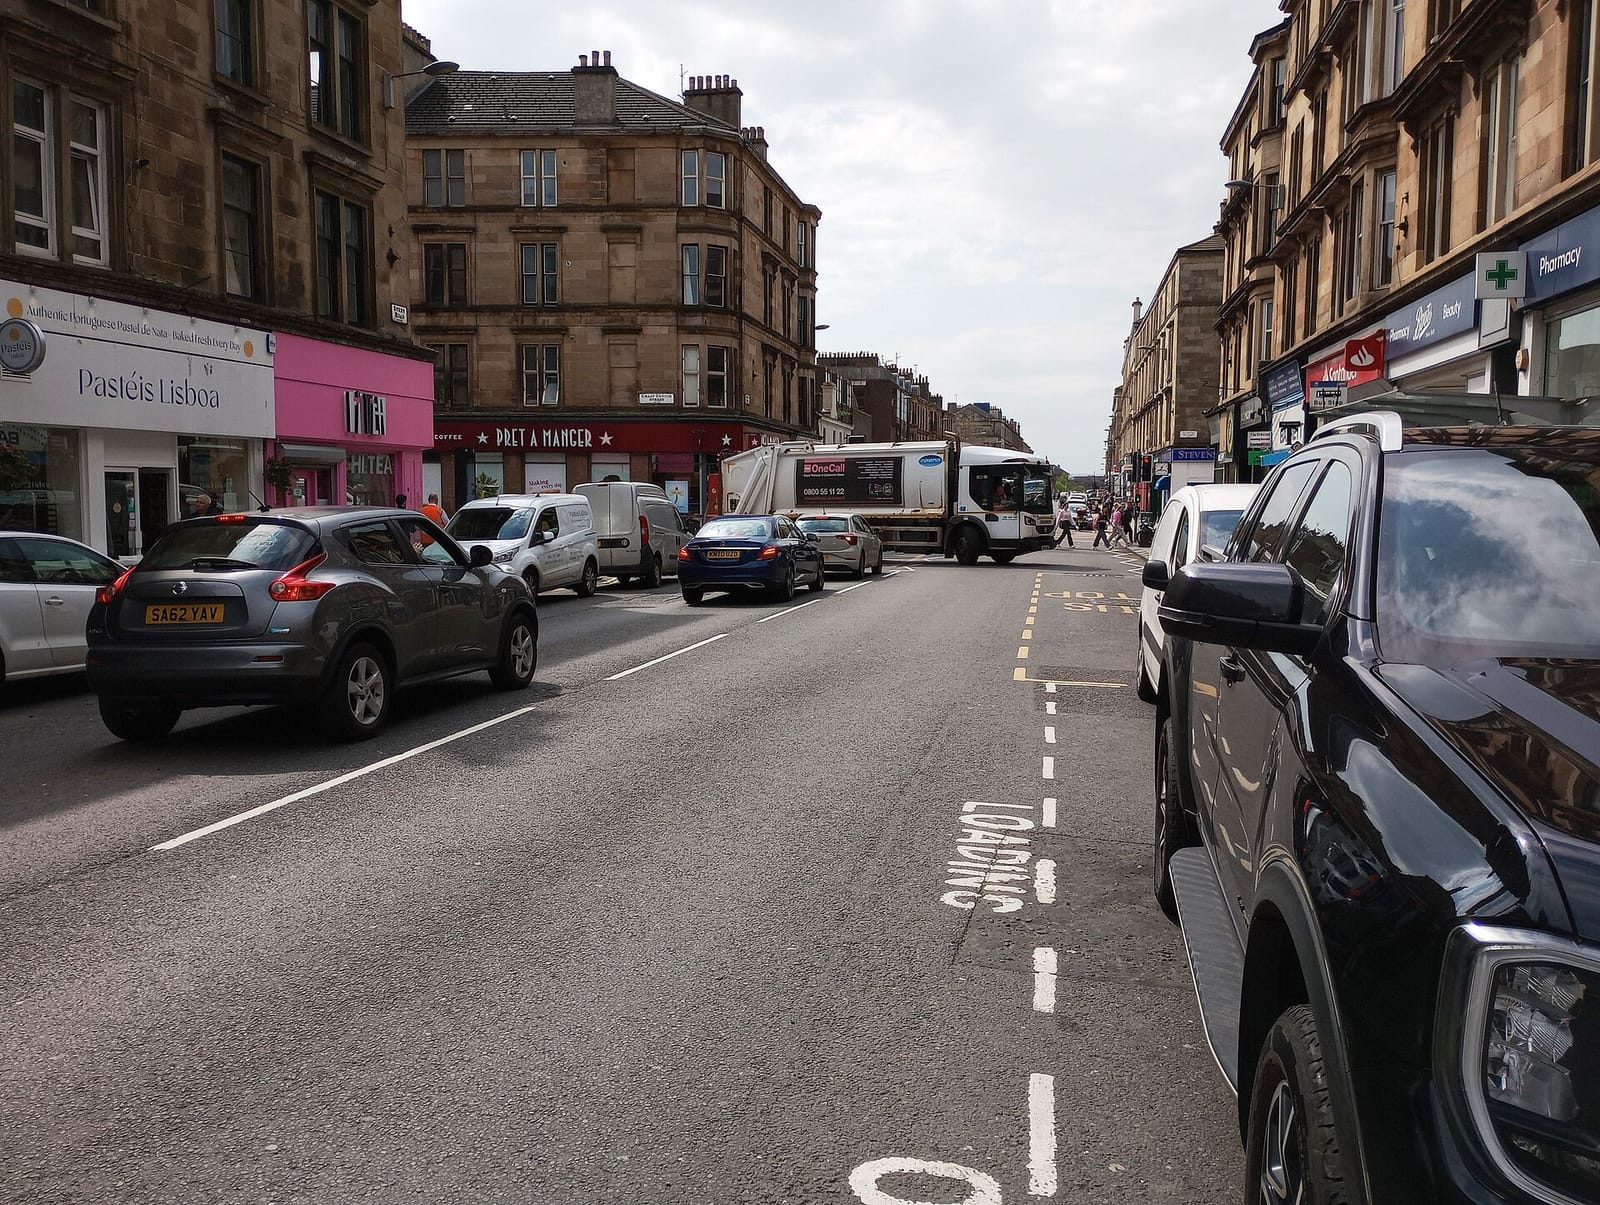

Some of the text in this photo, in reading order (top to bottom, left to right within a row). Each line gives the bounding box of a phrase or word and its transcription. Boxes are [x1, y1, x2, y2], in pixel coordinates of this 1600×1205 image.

[1539, 246, 1582, 277] Pharmacy
[27, 304, 242, 354] Authentic Portuguese Pastel de Nata Baked Fresh Every Day
[1389, 325, 1410, 343] Pharmacy
[1442, 299, 1462, 320] Beauty
[79, 368, 220, 409] Pastéis Lisboa
[434, 433, 463, 441] COFFEE
[496, 428, 593, 448] PRET A MANGER
[351, 455, 393, 476] HI TEA
[812, 463, 846, 473] OneCall
[803, 487, 846, 496] 0800 55 11 22
[151, 607, 218, 622] SA62 YAV
[939, 801, 1035, 913] LOADING
